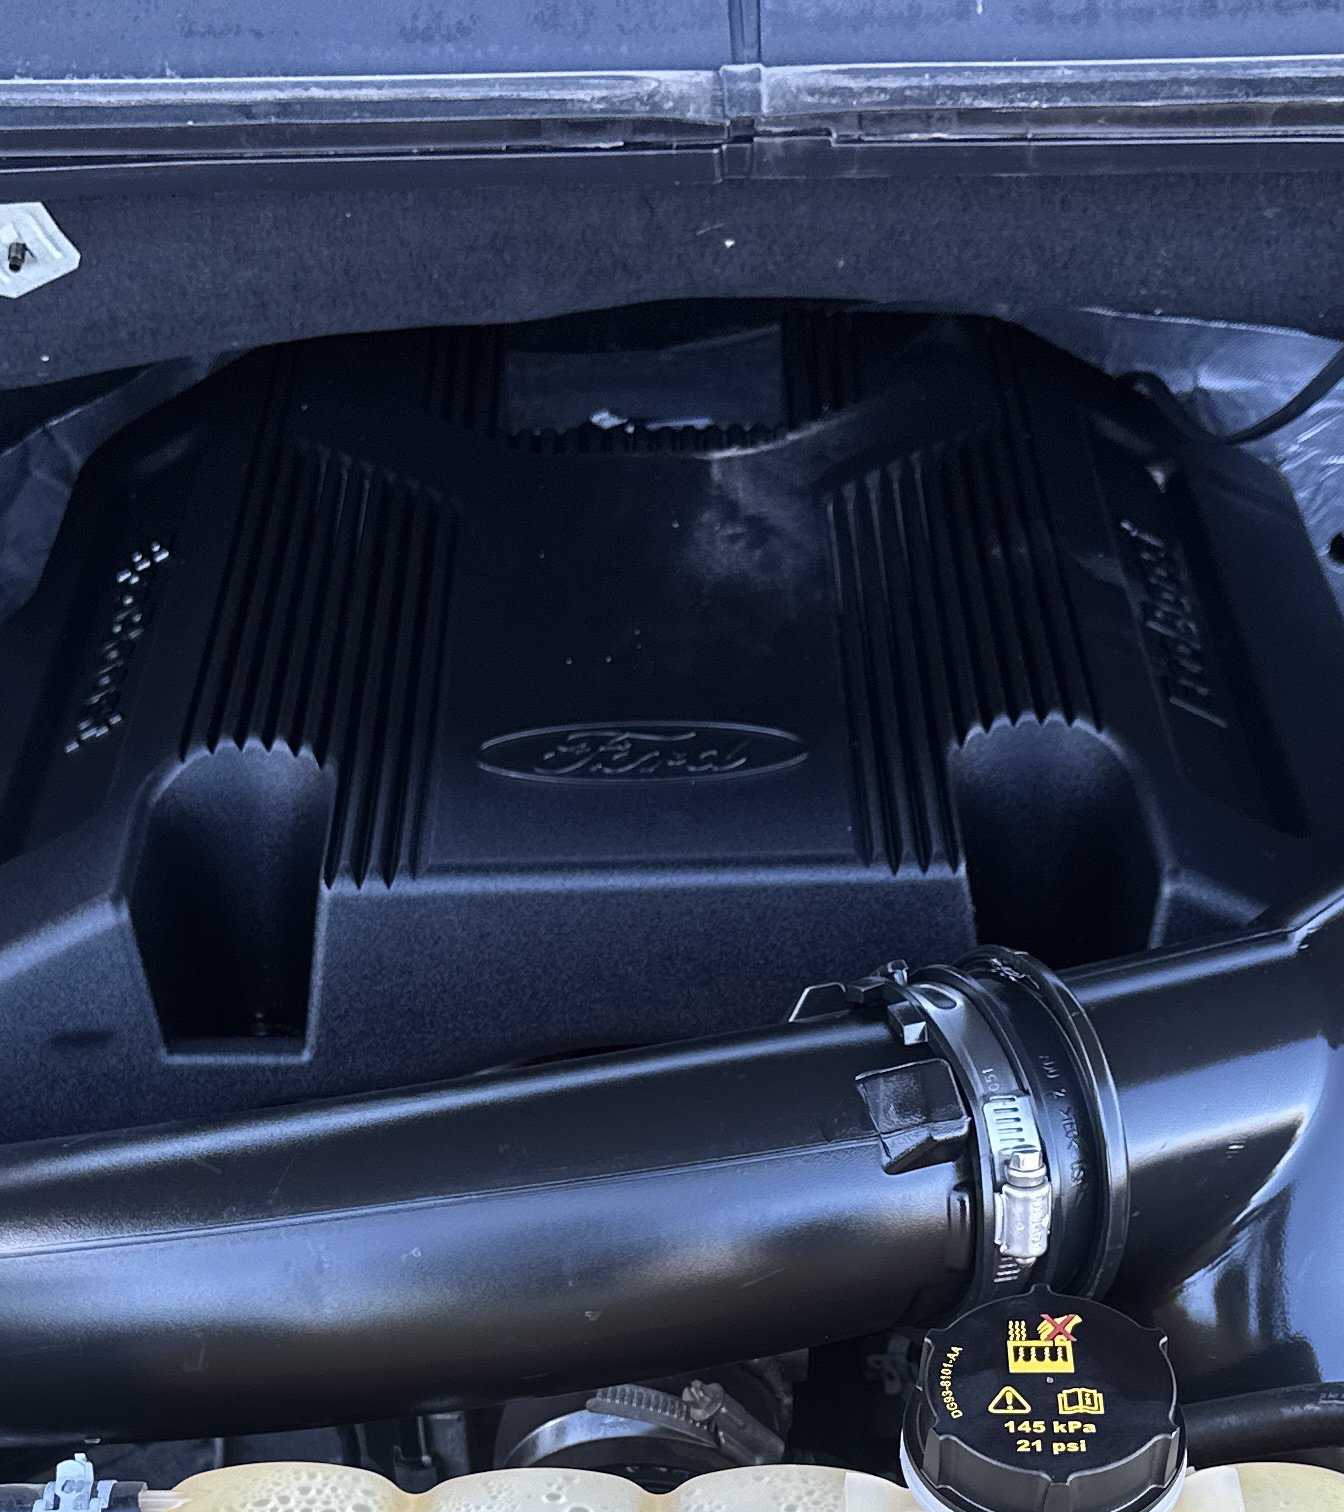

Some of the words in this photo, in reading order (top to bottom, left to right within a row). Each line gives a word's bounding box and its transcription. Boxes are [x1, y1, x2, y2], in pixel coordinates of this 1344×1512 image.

[526, 728, 754, 778] Ford
[939, 1346, 964, 1419] DG93-8101-AA
[1004, 1420, 1046, 1434] 145
[1053, 1420, 1096, 1434] kPa
[1016, 1439, 1042, 1453] 21
[1053, 1439, 1087, 1455] psi
